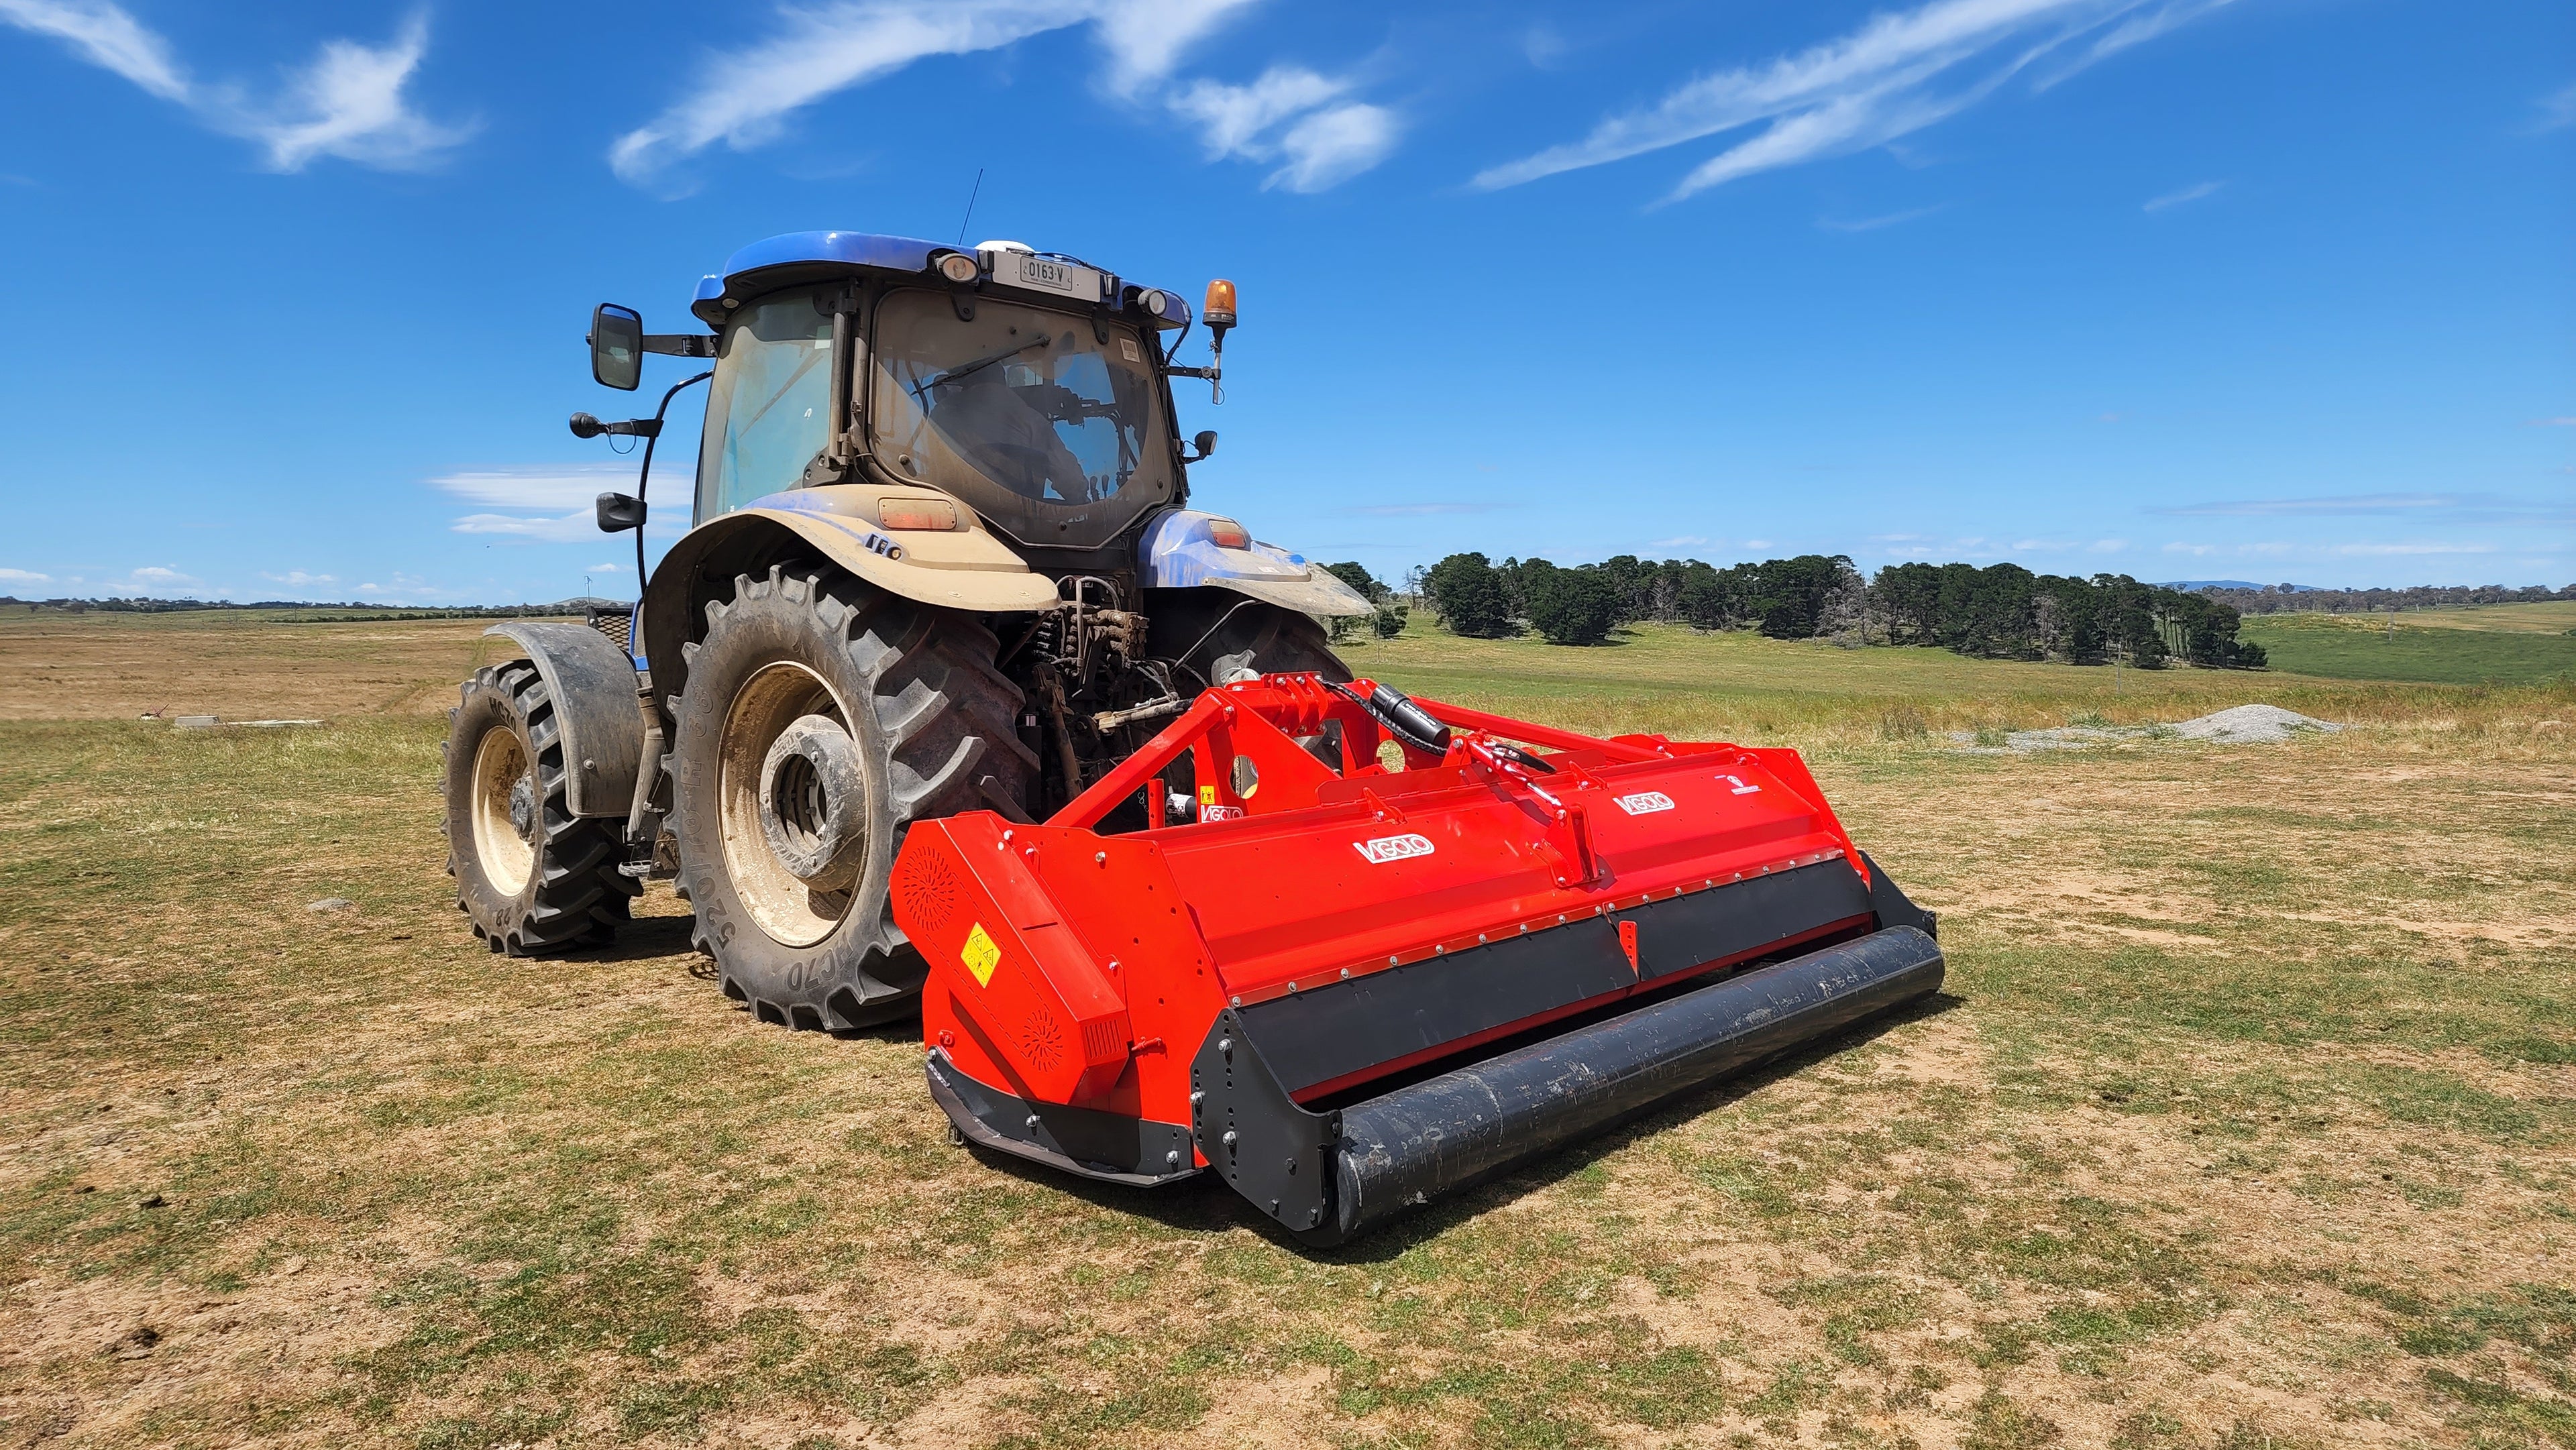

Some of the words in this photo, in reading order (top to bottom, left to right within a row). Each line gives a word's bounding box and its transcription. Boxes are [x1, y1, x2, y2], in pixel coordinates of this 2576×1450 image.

[488, 696, 517, 734] HC70
[1613, 793, 1674, 815] VIGOLO
[1353, 834, 1433, 862] VIGOLO
[787, 930, 853, 993] HC70
